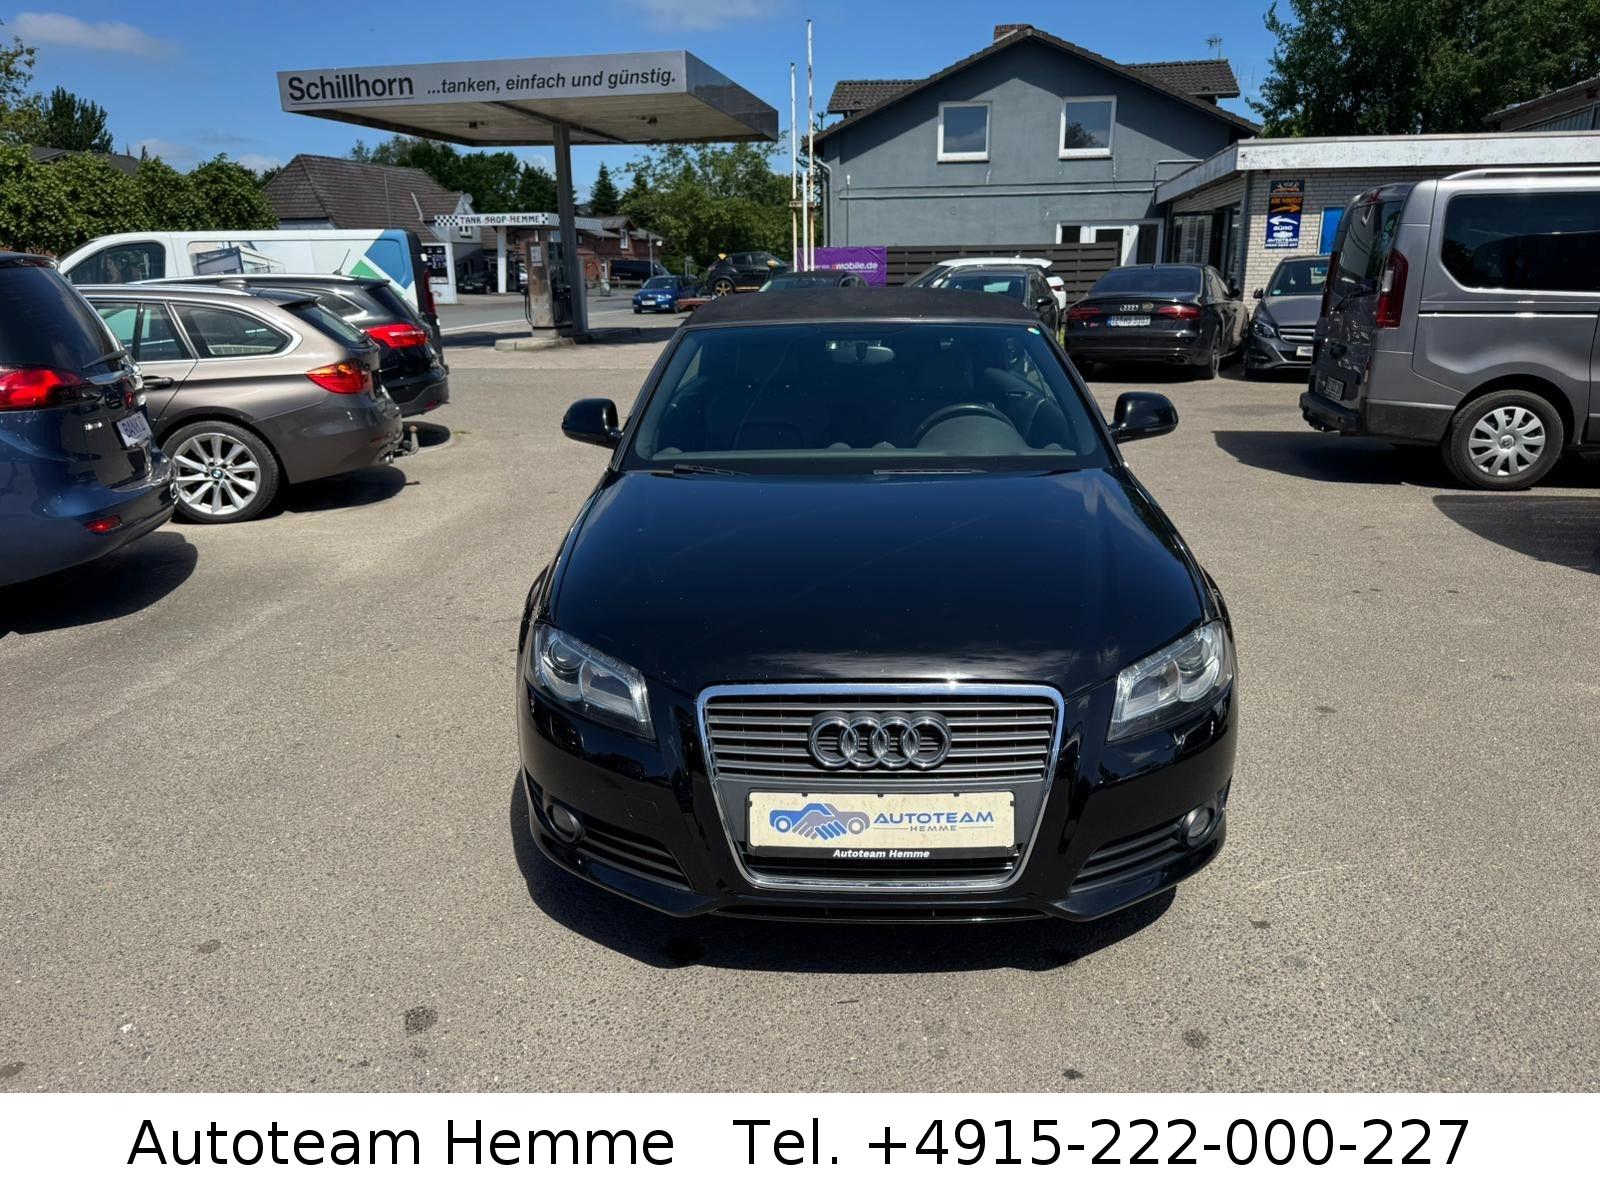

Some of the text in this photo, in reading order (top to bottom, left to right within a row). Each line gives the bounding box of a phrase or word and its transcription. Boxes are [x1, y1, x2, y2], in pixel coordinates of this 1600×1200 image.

[288, 67, 676, 102] Schillhorn ...tanken, einfach und günstig.
[836, 261, 878, 270] mobile.de
[873, 811, 994, 824] AUTOTEAM
[833, 849, 930, 858] Autoteam Hemme
